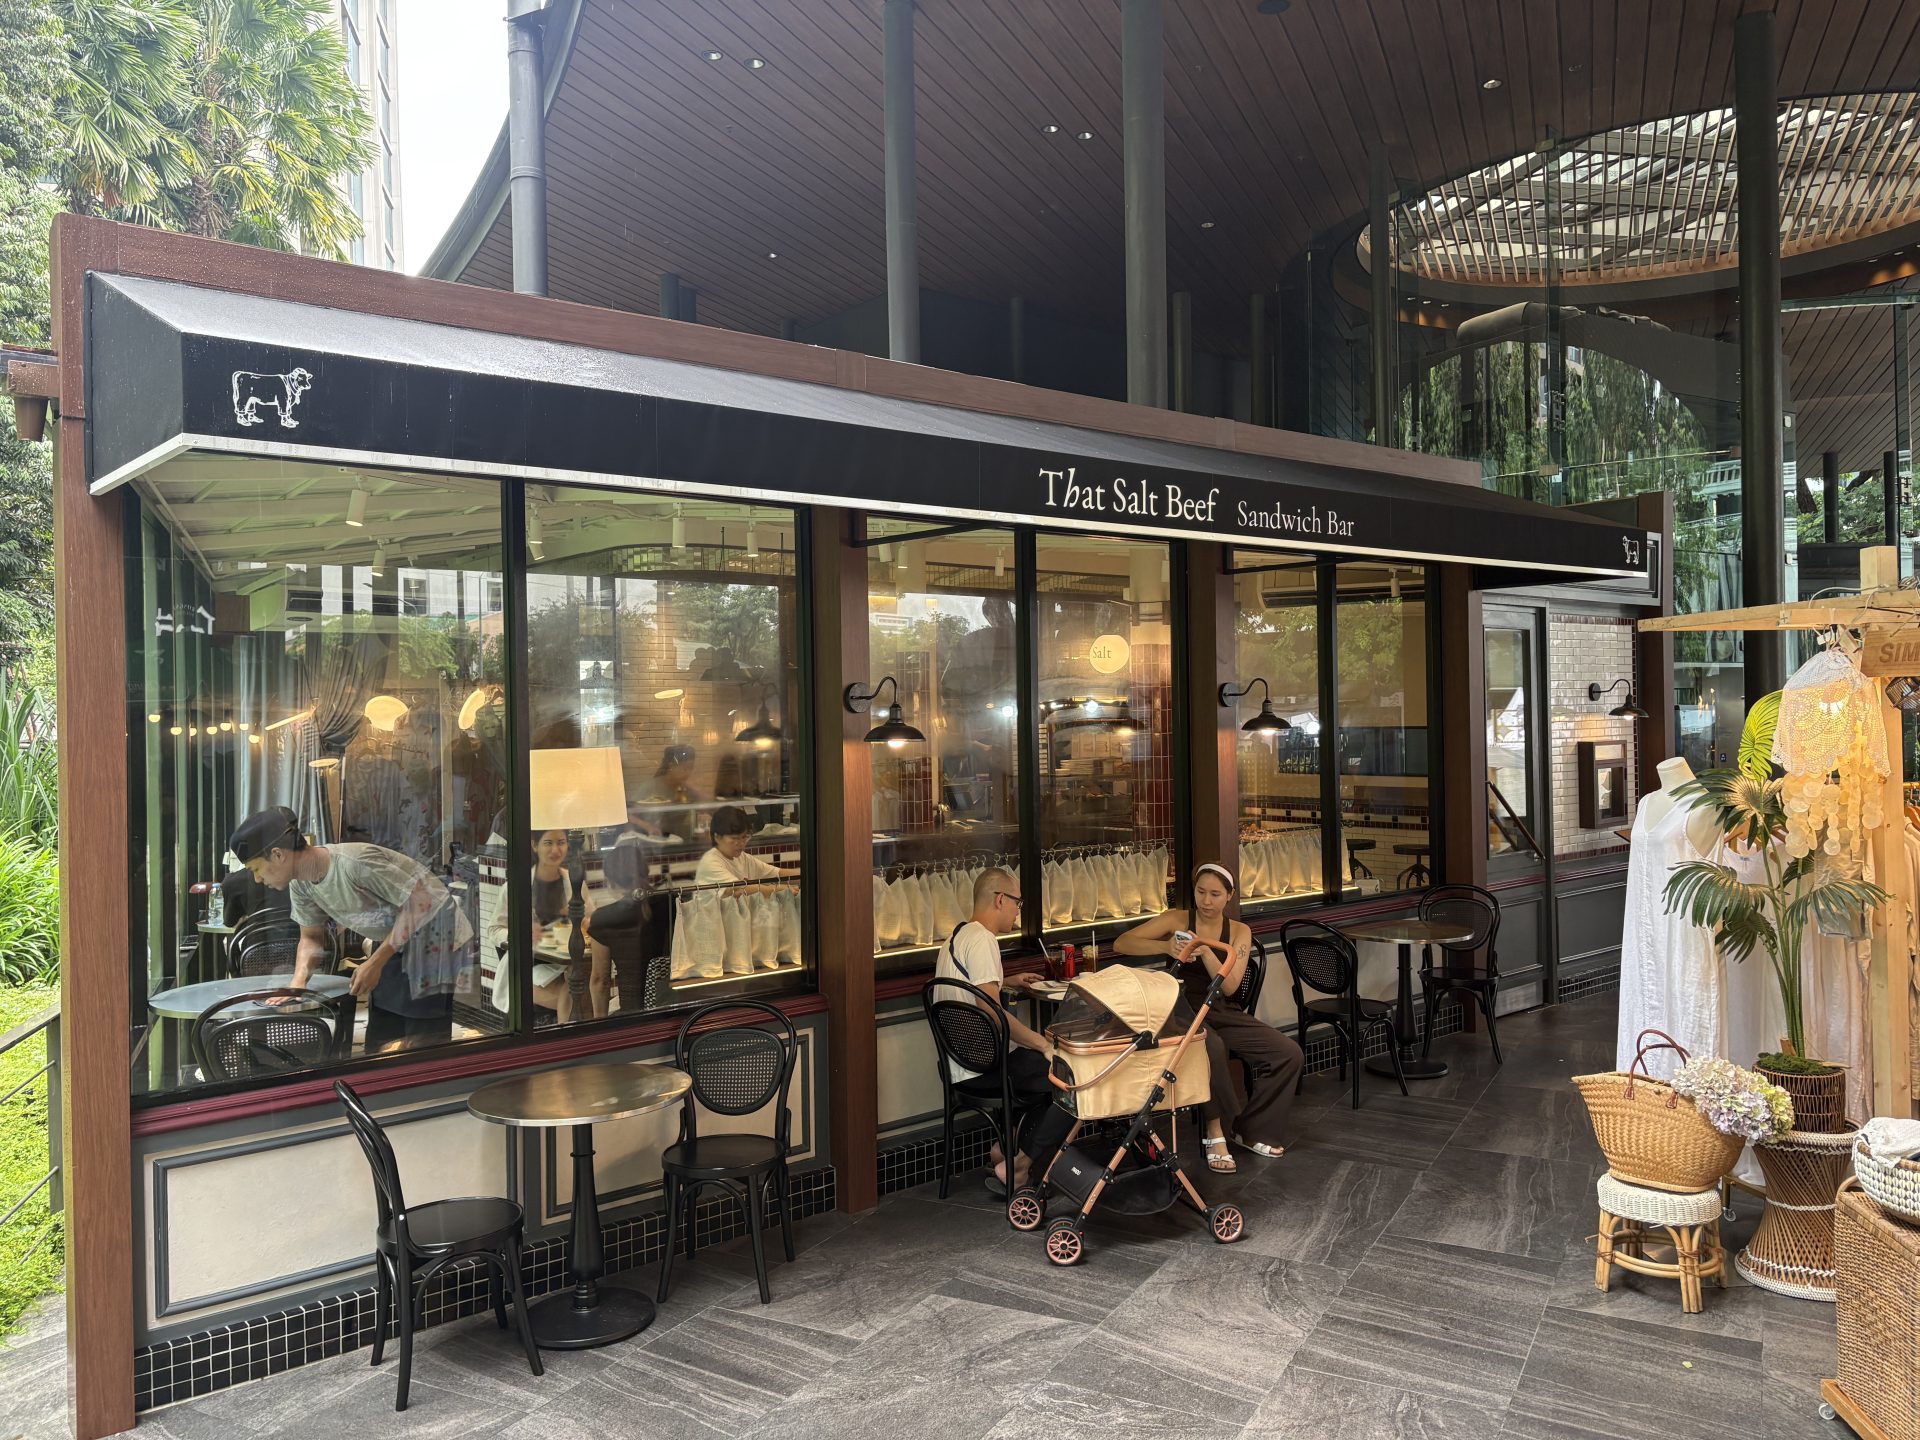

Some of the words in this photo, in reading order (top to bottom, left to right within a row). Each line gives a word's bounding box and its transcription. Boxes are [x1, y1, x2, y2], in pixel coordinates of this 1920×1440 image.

[1039, 467, 1106, 511] That
[1113, 478, 1159, 517] Salt
[1165, 484, 1220, 522] Beef
[1237, 500, 1322, 535] Sandwich
[1327, 510, 1355, 537] Bar
[1092, 645, 1112, 659] Salt
[1879, 641, 1920, 663] SIM
